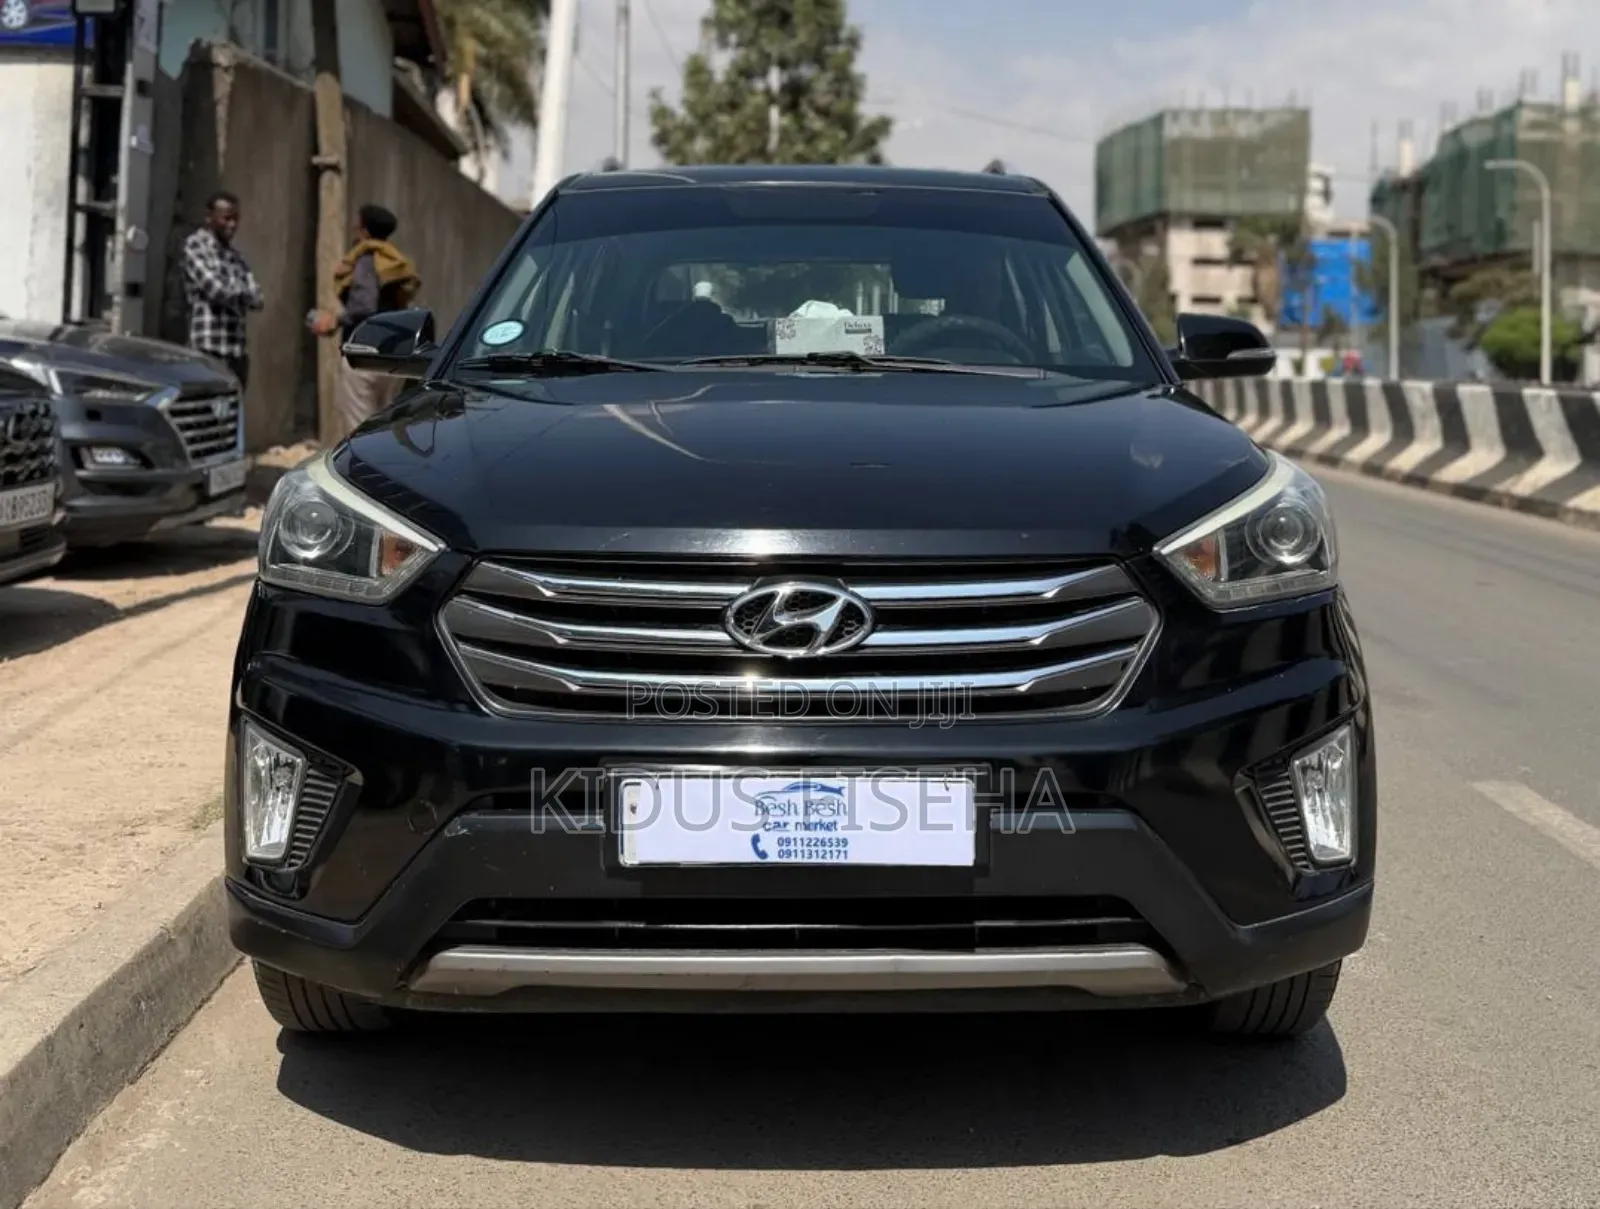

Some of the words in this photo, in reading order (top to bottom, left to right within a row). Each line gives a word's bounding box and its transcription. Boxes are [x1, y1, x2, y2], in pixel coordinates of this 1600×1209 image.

[754, 799, 799, 817] Besh
[803, 799, 847, 817] Besh
[762, 820, 790, 832] car
[777, 836, 848, 847] 0911226539
[777, 849, 848, 860] 0911312171
